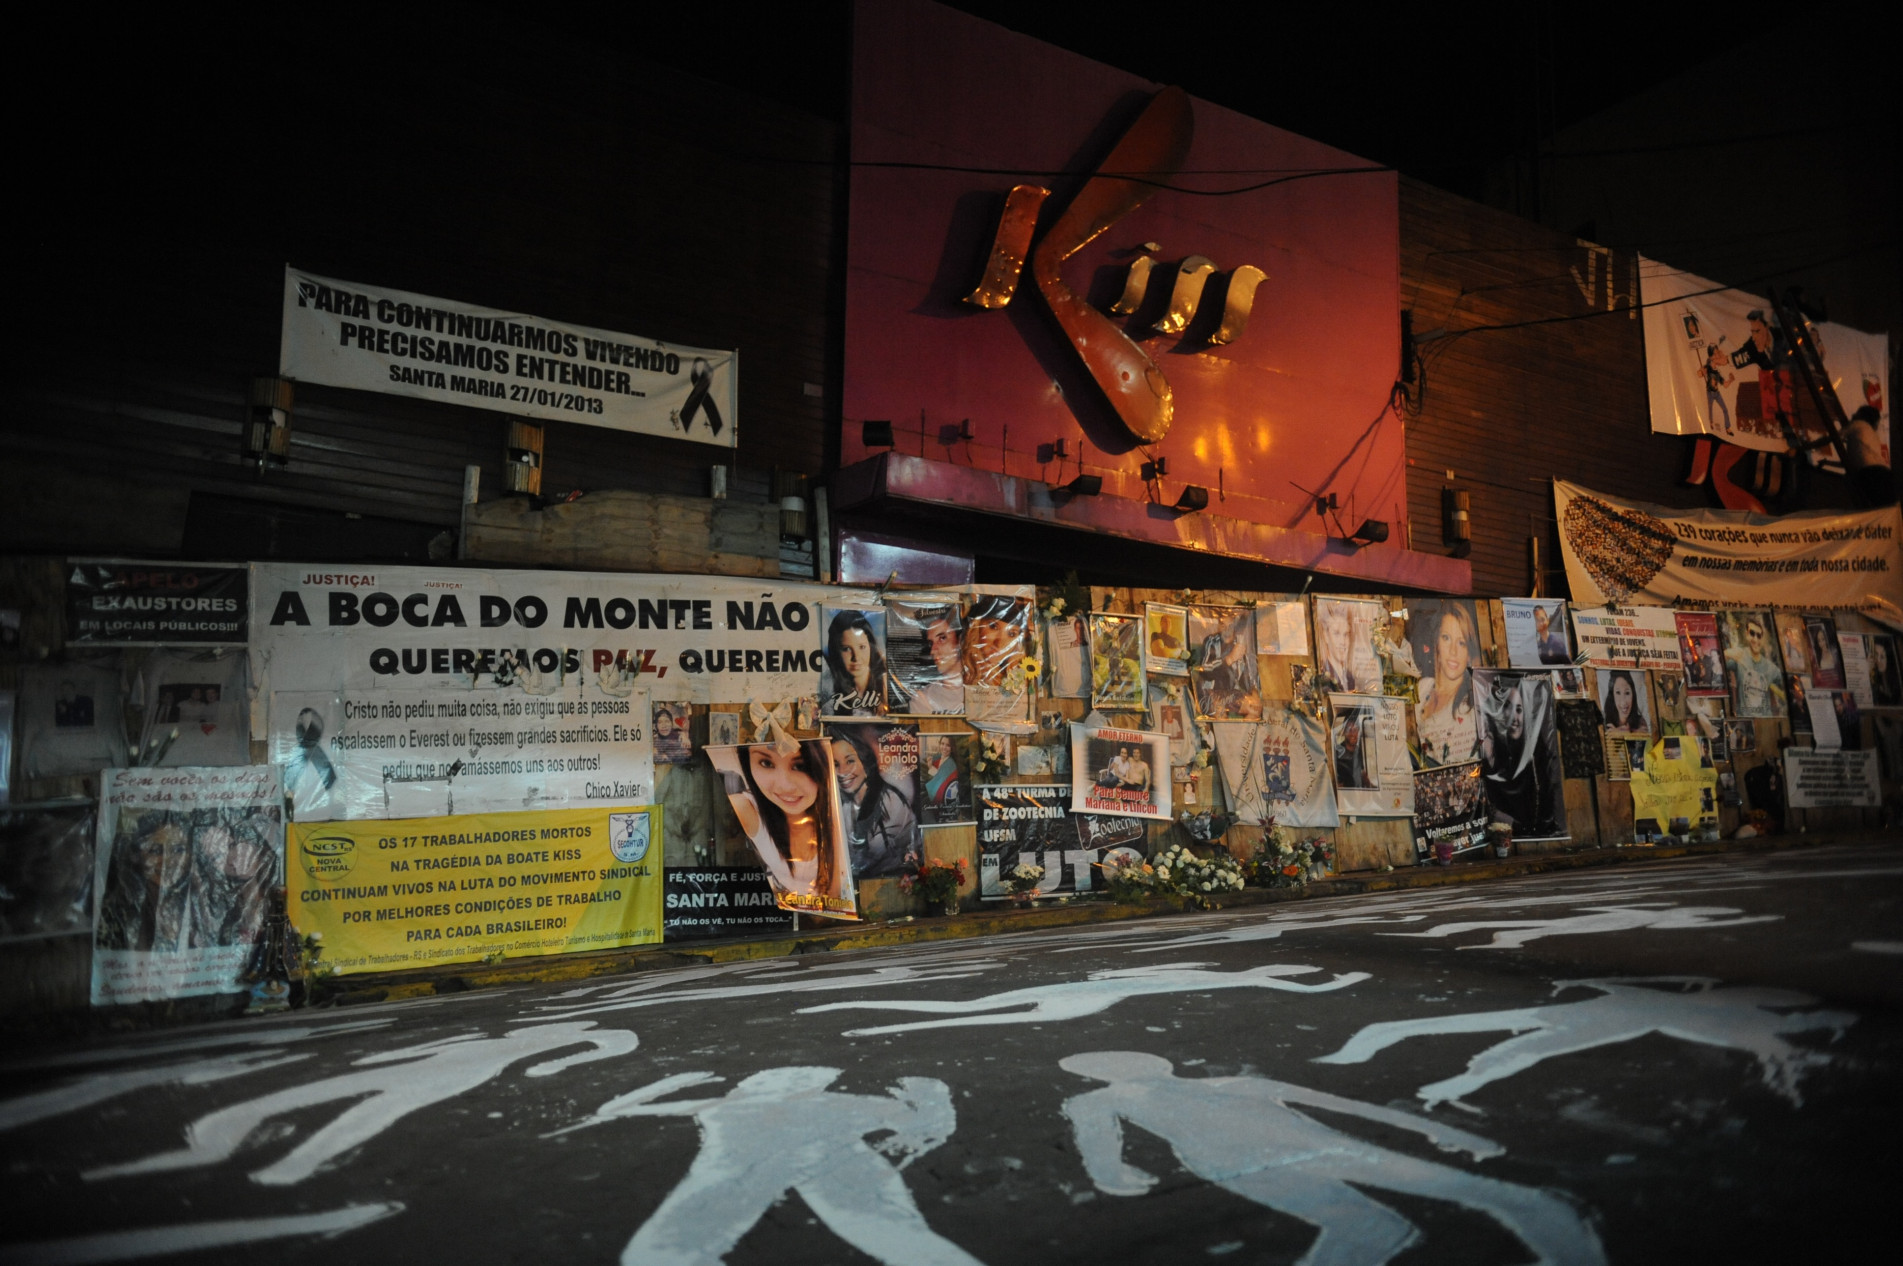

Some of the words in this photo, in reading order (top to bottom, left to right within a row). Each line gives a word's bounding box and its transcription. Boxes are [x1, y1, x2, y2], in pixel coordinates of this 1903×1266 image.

[298, 282, 371, 320] PARA
[376, 299, 579, 358] CONTINUARMOS
[583, 336, 681, 377] VIVENDO
[339, 320, 510, 376] PRECISAMOS
[515, 352, 646, 398] ENTENDER...
[389, 364, 447, 390] SANTA
[450, 374, 507, 400] MARIA
[510, 384, 604, 415] 27/01/2013
[1674, 521, 1697, 539] 239
[1698, 526, 1749, 546] corações
[1749, 532, 1769, 548] que
[1770, 529, 1801, 544] nunca
[1800, 528, 1821, 543] vão
[1682, 554, 1698, 568] em
[1699, 555, 1732, 570] nossas
[1786, 558, 1800, 572] em
[1821, 558, 1849, 572] nossa
[1852, 556, 1890, 572] cidade.
[303, 574, 375, 588] JUSTIÇA!
[423, 581, 463, 589] JUSTIÇA!
[92, 595, 239, 613] EXAUSTORES
[269, 591, 311, 626] A
[328, 591, 468, 628] BOCA
[479, 594, 549, 628] DO
[563, 596, 713, 630] MONTE
[726, 591, 811, 631] NÃO
[1506, 610, 1532, 619] BRUNO
[79, 619, 101, 632] EM
[104, 620, 156, 632] LOCAIS
[159, 619, 239, 632] PÚBLICOS!!!
[369, 647, 580, 676] QUEREMOS
[832, 690, 881, 711] Kelli
[344, 700, 378, 719] Cristo
[382, 700, 402, 718] não
[405, 700, 434, 723] pediu
[438, 699, 466, 717] muita
[470, 698, 501, 720] coisa,
[503, 699, 522, 716] não
[525, 698, 554, 719] exigiu
[557, 701, 575, 719] que
[577, 700, 588, 715] as
[591, 700, 630, 718] pessoas
[331, 731, 396, 750] escalassem
[399, 737, 406, 748] o
[409, 729, 450, 748] Everest
[453, 734, 466, 746] ou
[469, 728, 514, 746] fizessem
[517, 726, 557, 749] grandes
[613, 725, 628, 742] Ele
[630, 723, 642, 742] só
[1098, 729, 1117, 741] AMOR
[1118, 731, 1144, 744] ETERNO
[878, 742, 918, 754] Leandra
[1300, 740, 1316, 773] Santa
[461, 757, 523, 776] amássemos
[526, 759, 544, 774] uns
[547, 758, 564, 772] aos
[567, 753, 601, 772] outros!
[878, 753, 918, 765] Toniolo
[585, 781, 611, 798] Chico
[613, 781, 641, 798] Xavier
[1016, 787, 1056, 799] TURMA
[1094, 784, 1114, 799] Para
[1115, 786, 1150, 803] Sempre
[1085, 797, 1121, 812] Mariana
[1123, 803, 1128, 812] e
[983, 808, 1000, 821] DE
[378, 837, 398, 850] OS
[402, 836, 418, 848] 17
[421, 829, 537, 847] TRABALHADORES
[540, 826, 592, 840] MORTOS
[984, 828, 1017, 842] UFSM
[312, 842, 346, 852] NCST
[309, 865, 350, 873] CENTRAL
[317, 858, 342, 866] NOVA
[390, 860, 410, 873] NA
[414, 854, 482, 871] TRAGÉDIA
[485, 853, 503, 867] DA
[506, 851, 550, 866] BOATE
[553, 849, 582, 861] KISS
[982, 857, 998, 867] EM
[300, 885, 388, 903] CONTINUAM
[392, 882, 434, 895] VIVOS
[438, 880, 458, 893] NA
[460, 875, 494, 891] LUTA
[498, 875, 517, 888] DO
[521, 869, 597, 887] MOVIMENTO
[599, 865, 652, 881] SINDICAL
[669, 871, 687, 884] FÉ,
[690, 872, 728, 884] FORÇA
[731, 873, 737, 881] E
[342, 910, 372, 924] POR
[376, 904, 451, 921] MELHORES
[454, 896, 533, 915] CONDIÇÕES
[536, 895, 553, 908] DE
[556, 889, 622, 906] TRABALHO
[666, 893, 729, 908] SANTA
[682, 917, 698, 926] NÃO
[700, 917, 711, 925] OS
[726, 917, 736, 925] TU
[738, 916, 752, 925] NÃO
[754, 916, 763, 924] OS
[406, 928, 442, 943] PARA
[446, 923, 483, 939] CADA
[486, 917, 568, 936] BRASILEIRO!
